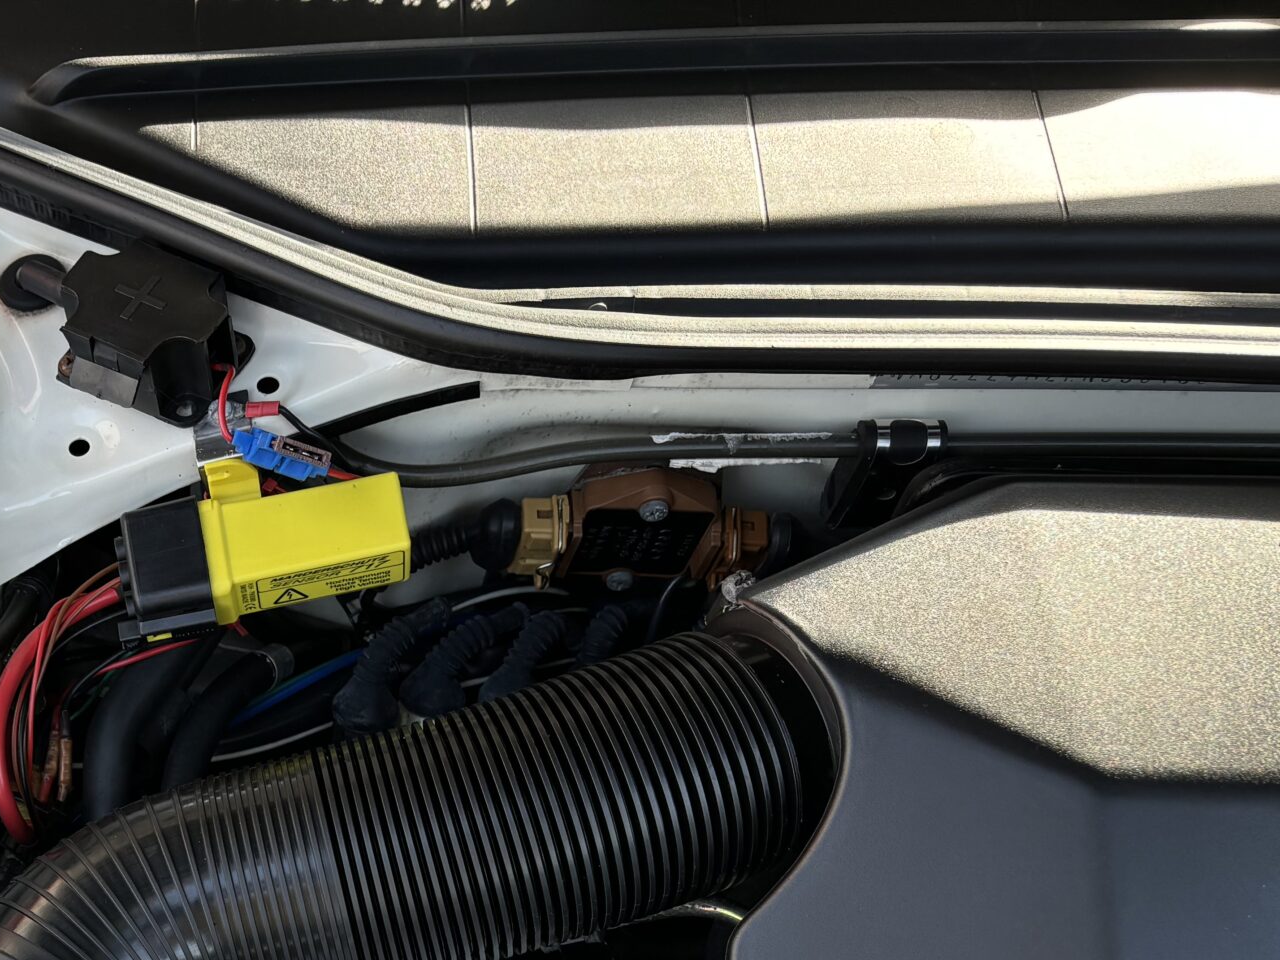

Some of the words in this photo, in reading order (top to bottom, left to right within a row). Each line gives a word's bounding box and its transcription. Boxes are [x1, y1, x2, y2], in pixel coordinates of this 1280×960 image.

[270, 555, 391, 583] MARDERSCHUTZ
[271, 570, 342, 589] SENSOR
[325, 570, 391, 586] Hochspannung
[330, 579, 357, 590] Haute
[359, 574, 391, 584] Tension
[335, 583, 355, 592] High
[357, 577, 391, 588] Voltage
